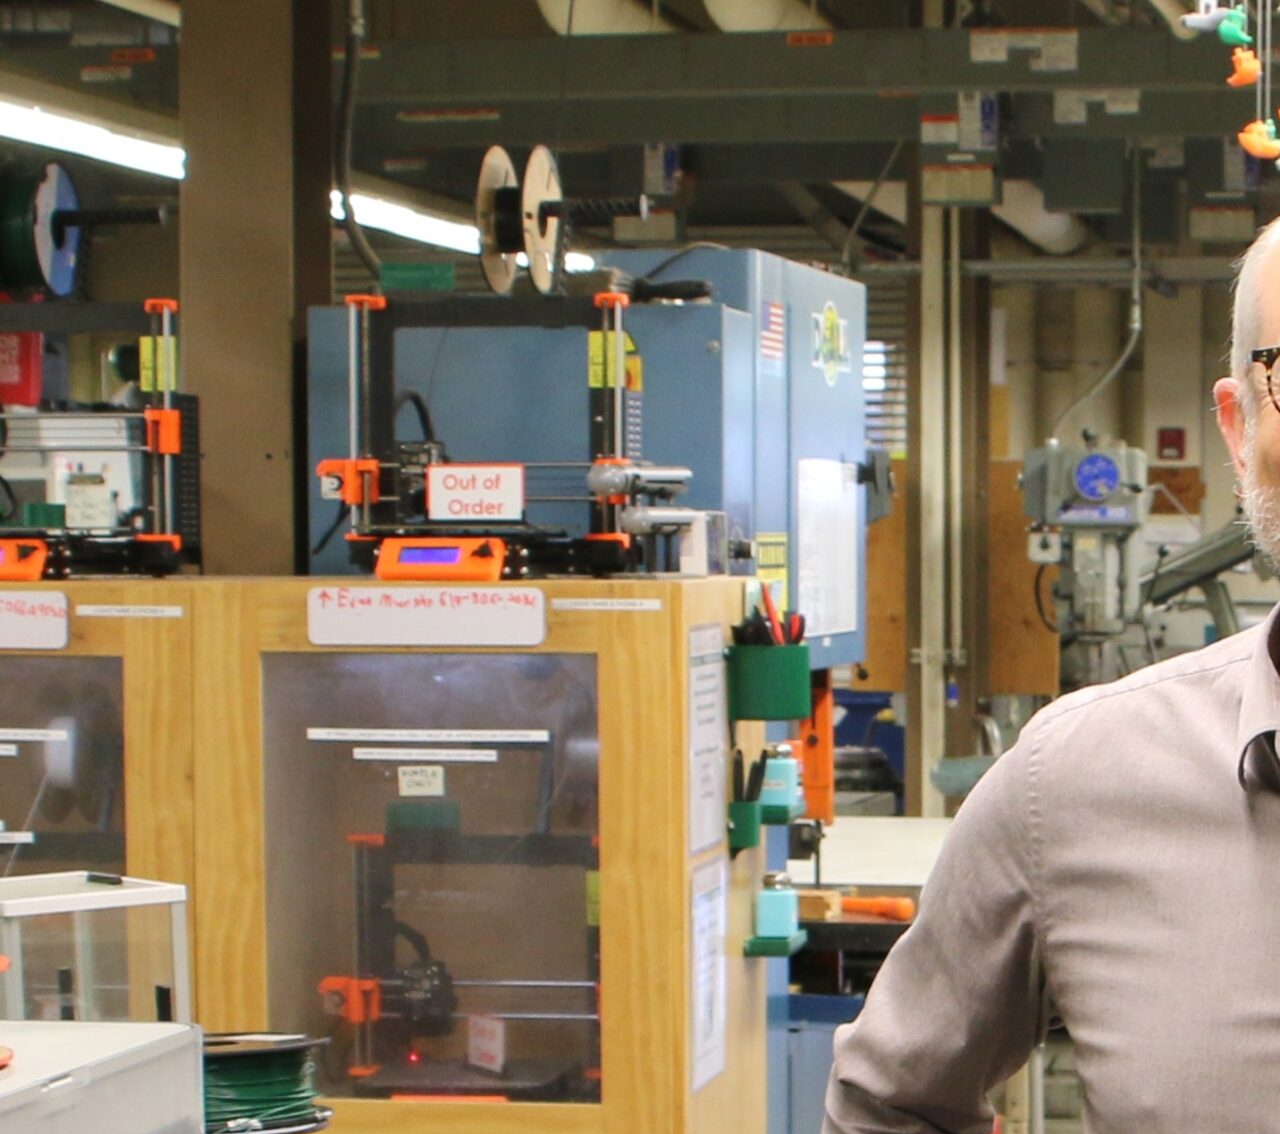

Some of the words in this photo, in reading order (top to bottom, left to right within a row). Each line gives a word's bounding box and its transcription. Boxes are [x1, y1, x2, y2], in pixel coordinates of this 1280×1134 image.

[442, 473, 476, 490] Out
[482, 473, 501, 490] of
[448, 498, 503, 516] Order
